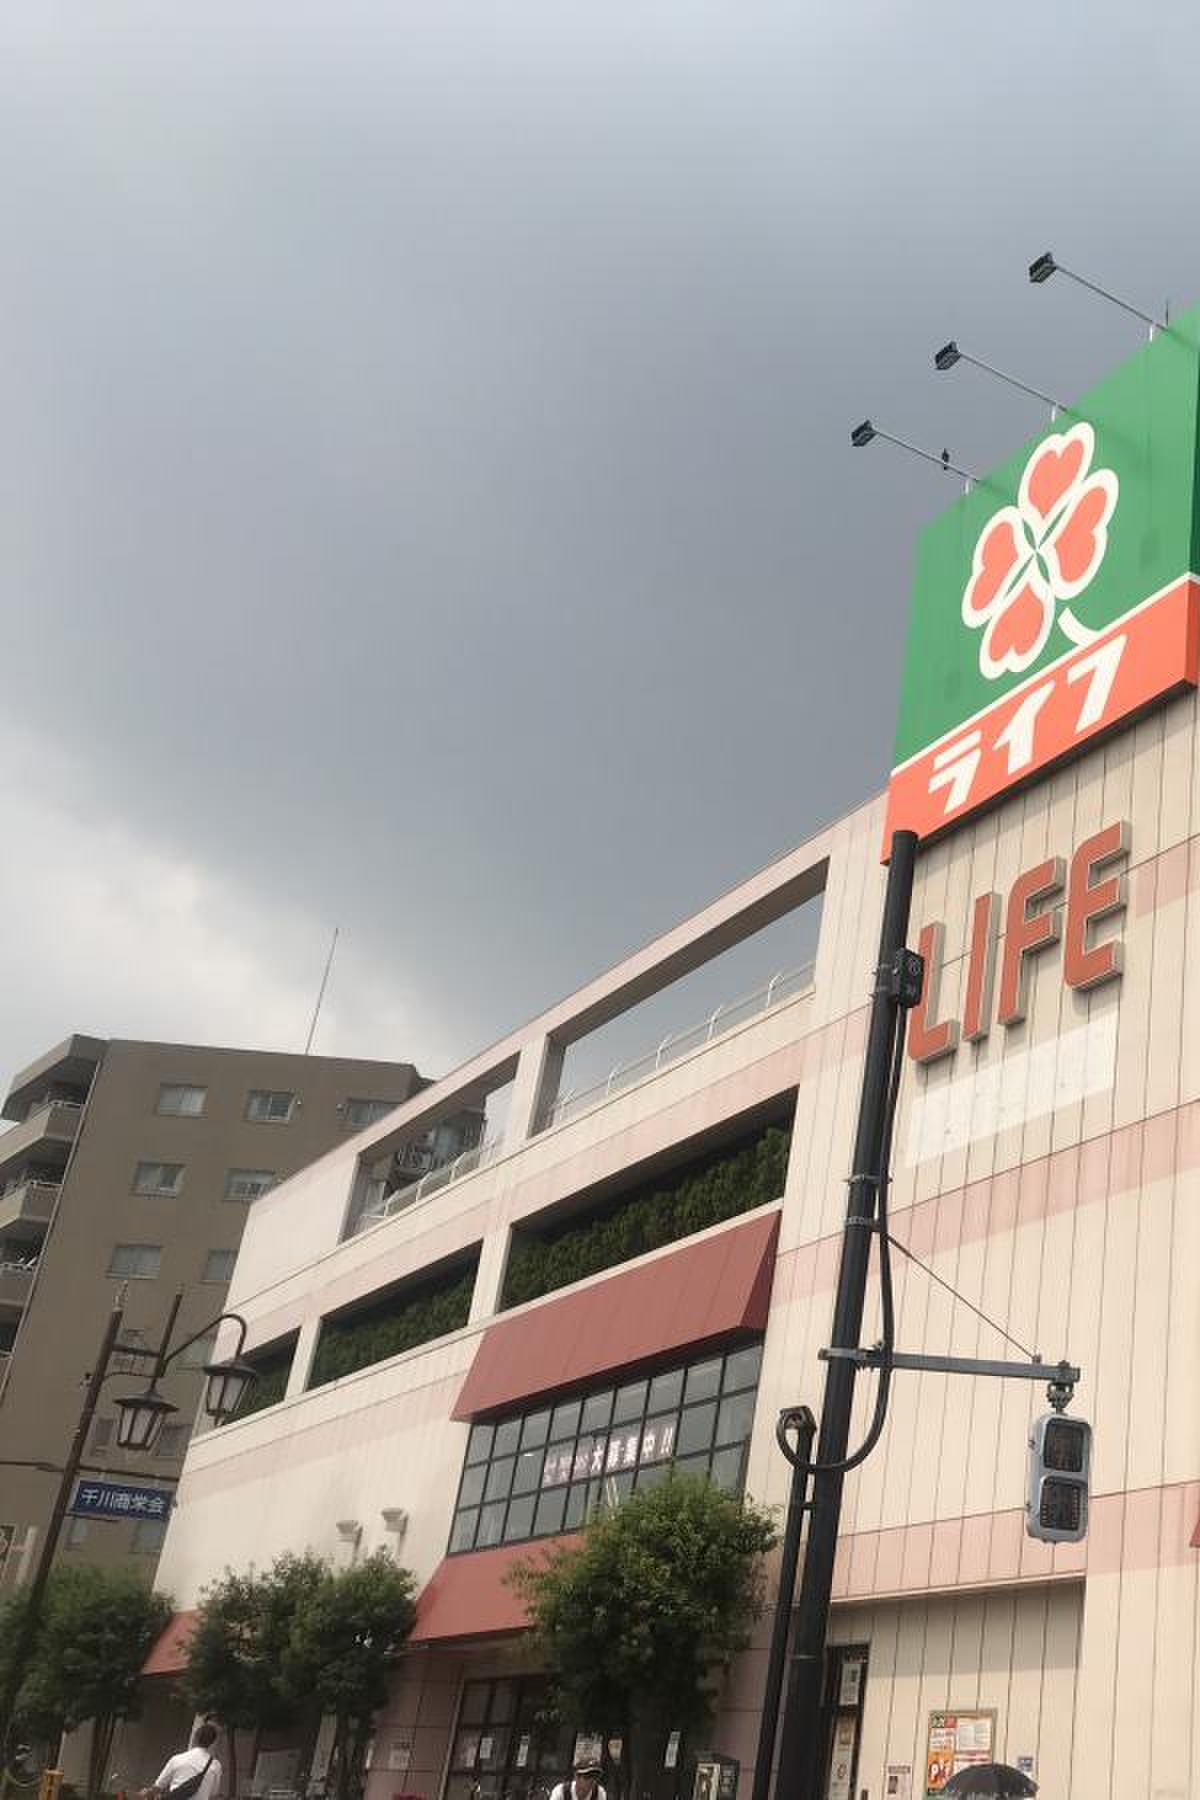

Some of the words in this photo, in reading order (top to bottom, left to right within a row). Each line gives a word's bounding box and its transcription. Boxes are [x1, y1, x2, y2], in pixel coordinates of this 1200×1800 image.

[927, 634, 1127, 814] ライフ
[907, 820, 1131, 1063] LIFE
